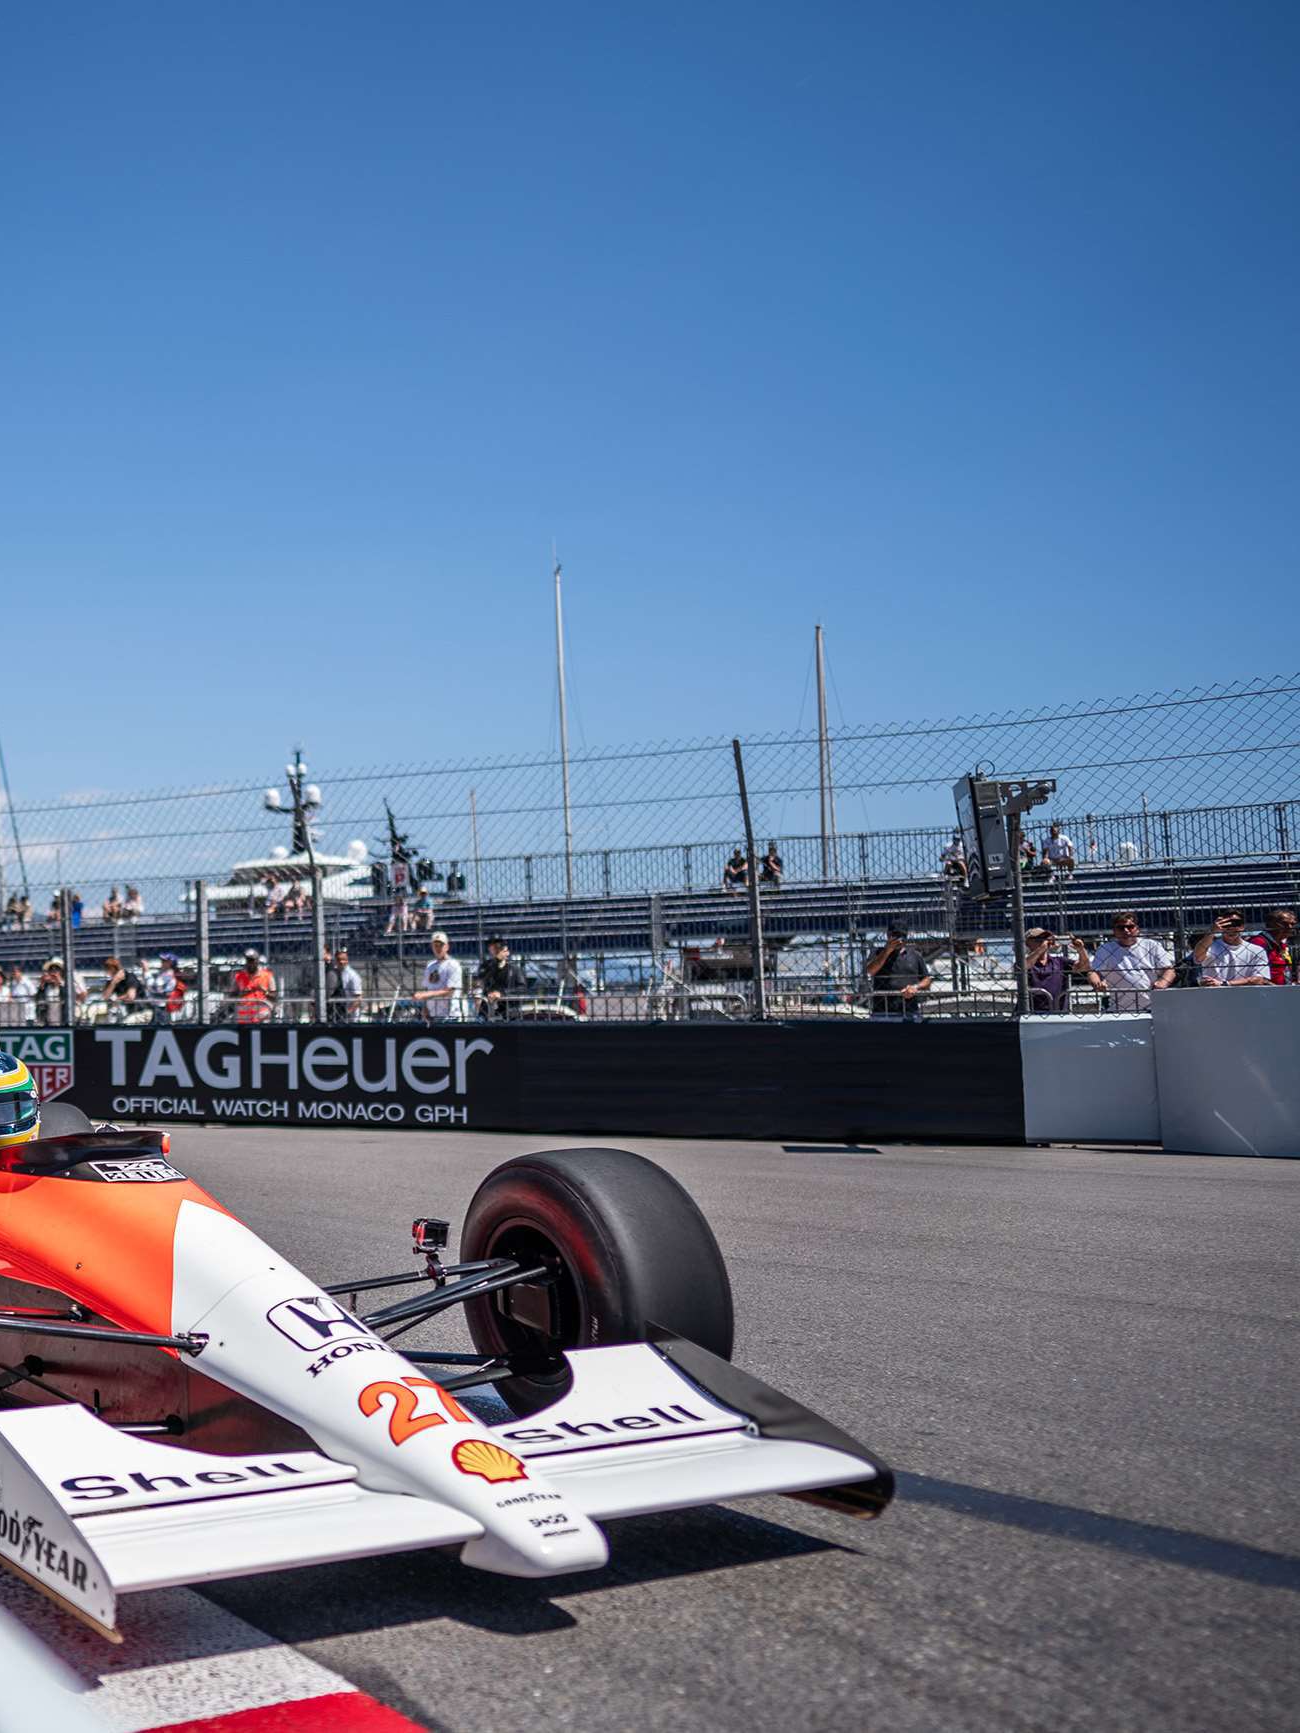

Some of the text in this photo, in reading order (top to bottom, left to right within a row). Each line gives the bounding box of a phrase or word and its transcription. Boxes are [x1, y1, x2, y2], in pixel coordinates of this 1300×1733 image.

[0, 1035, 66, 1060] TAG
[112, 1096, 468, 1124] OFFICIAL WATCH MONACO GPH
[358, 1377, 474, 1446] 27
[503, 1405, 705, 1444] Shell
[60, 1462, 304, 1500] Shell
